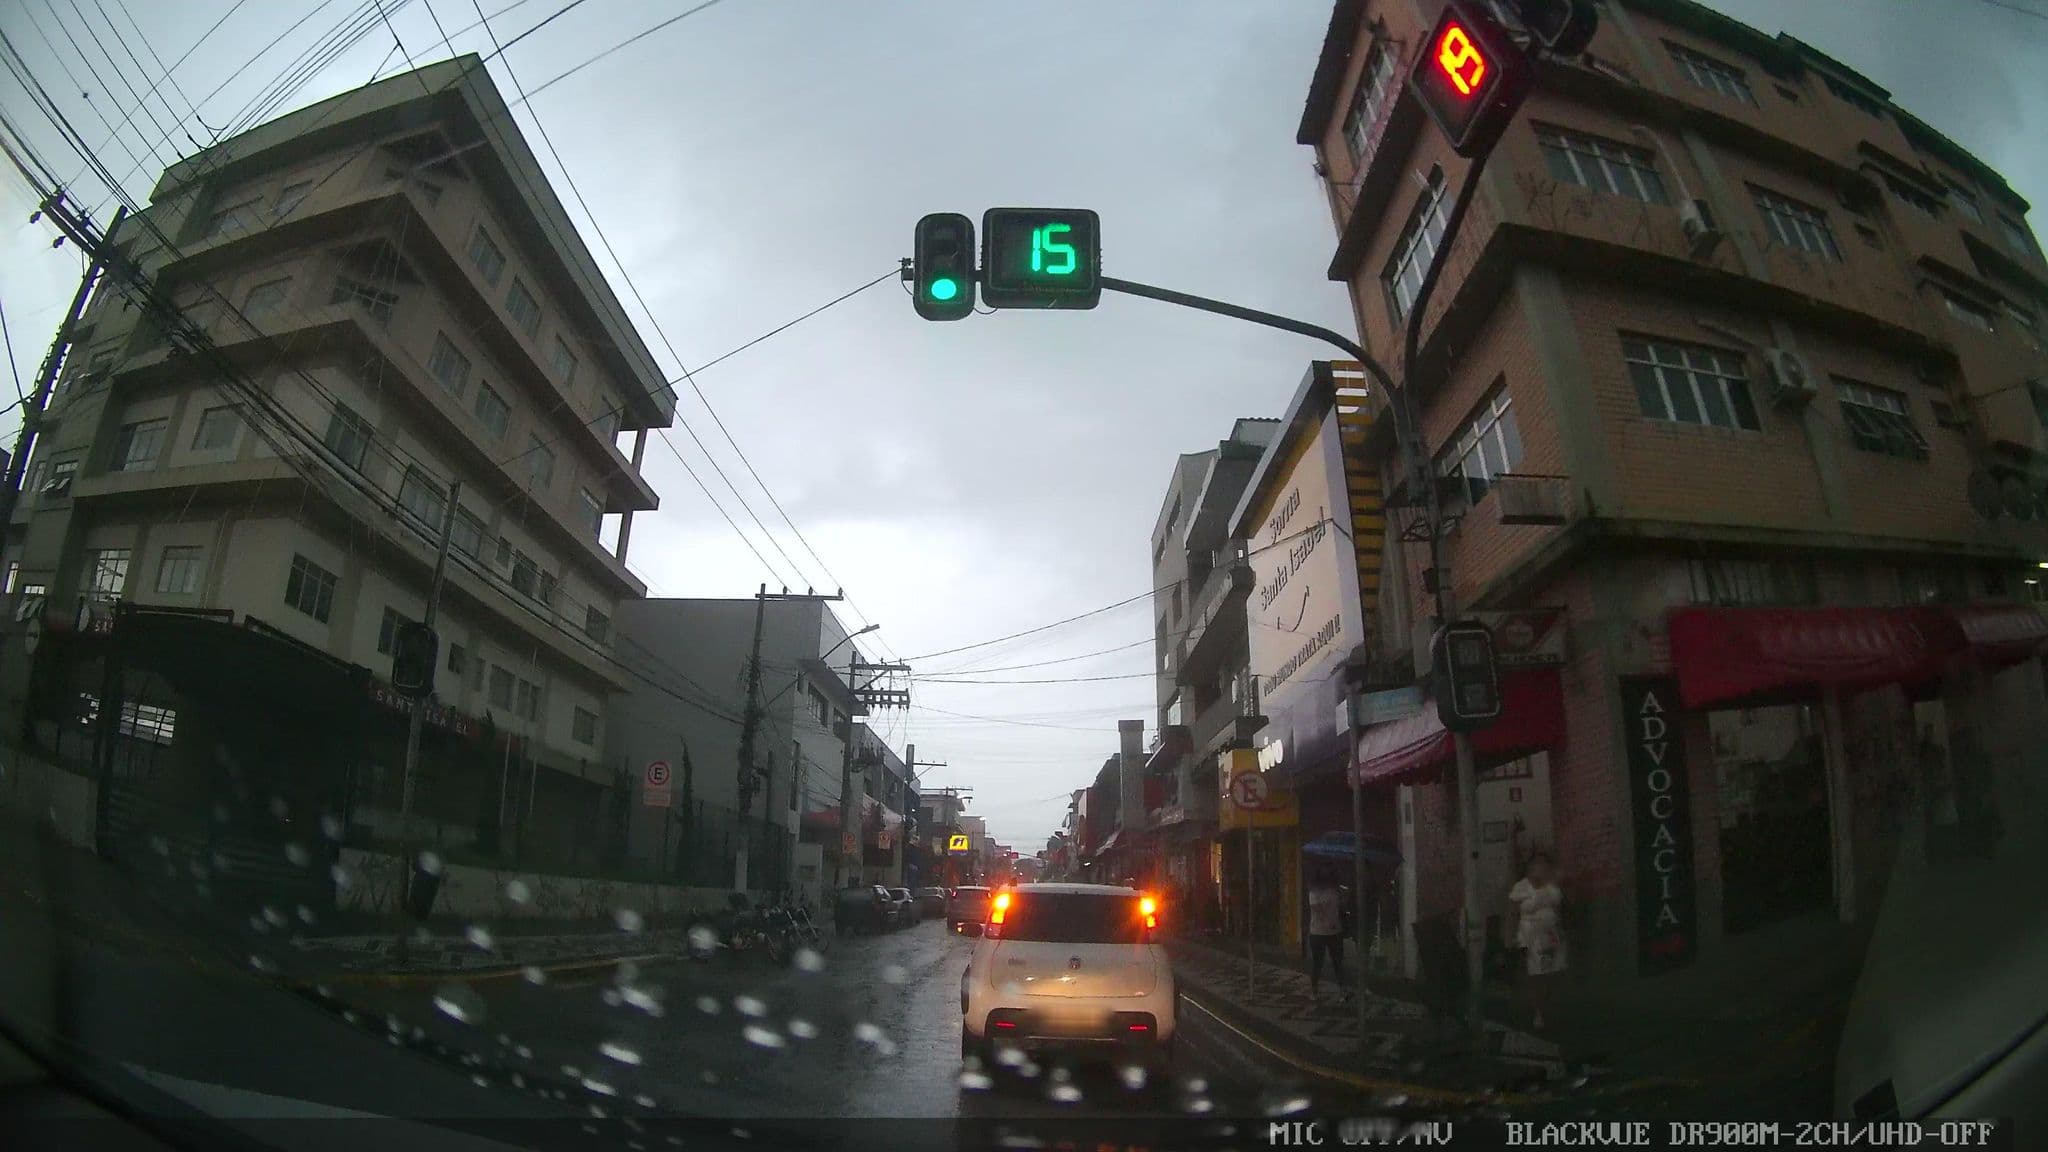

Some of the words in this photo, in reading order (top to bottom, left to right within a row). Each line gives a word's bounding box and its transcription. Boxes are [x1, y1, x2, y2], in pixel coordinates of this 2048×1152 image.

[1031, 223, 1076, 274] 15
[654, 767, 664, 780] E
[1639, 690, 1680, 928] ADVOCACIA
